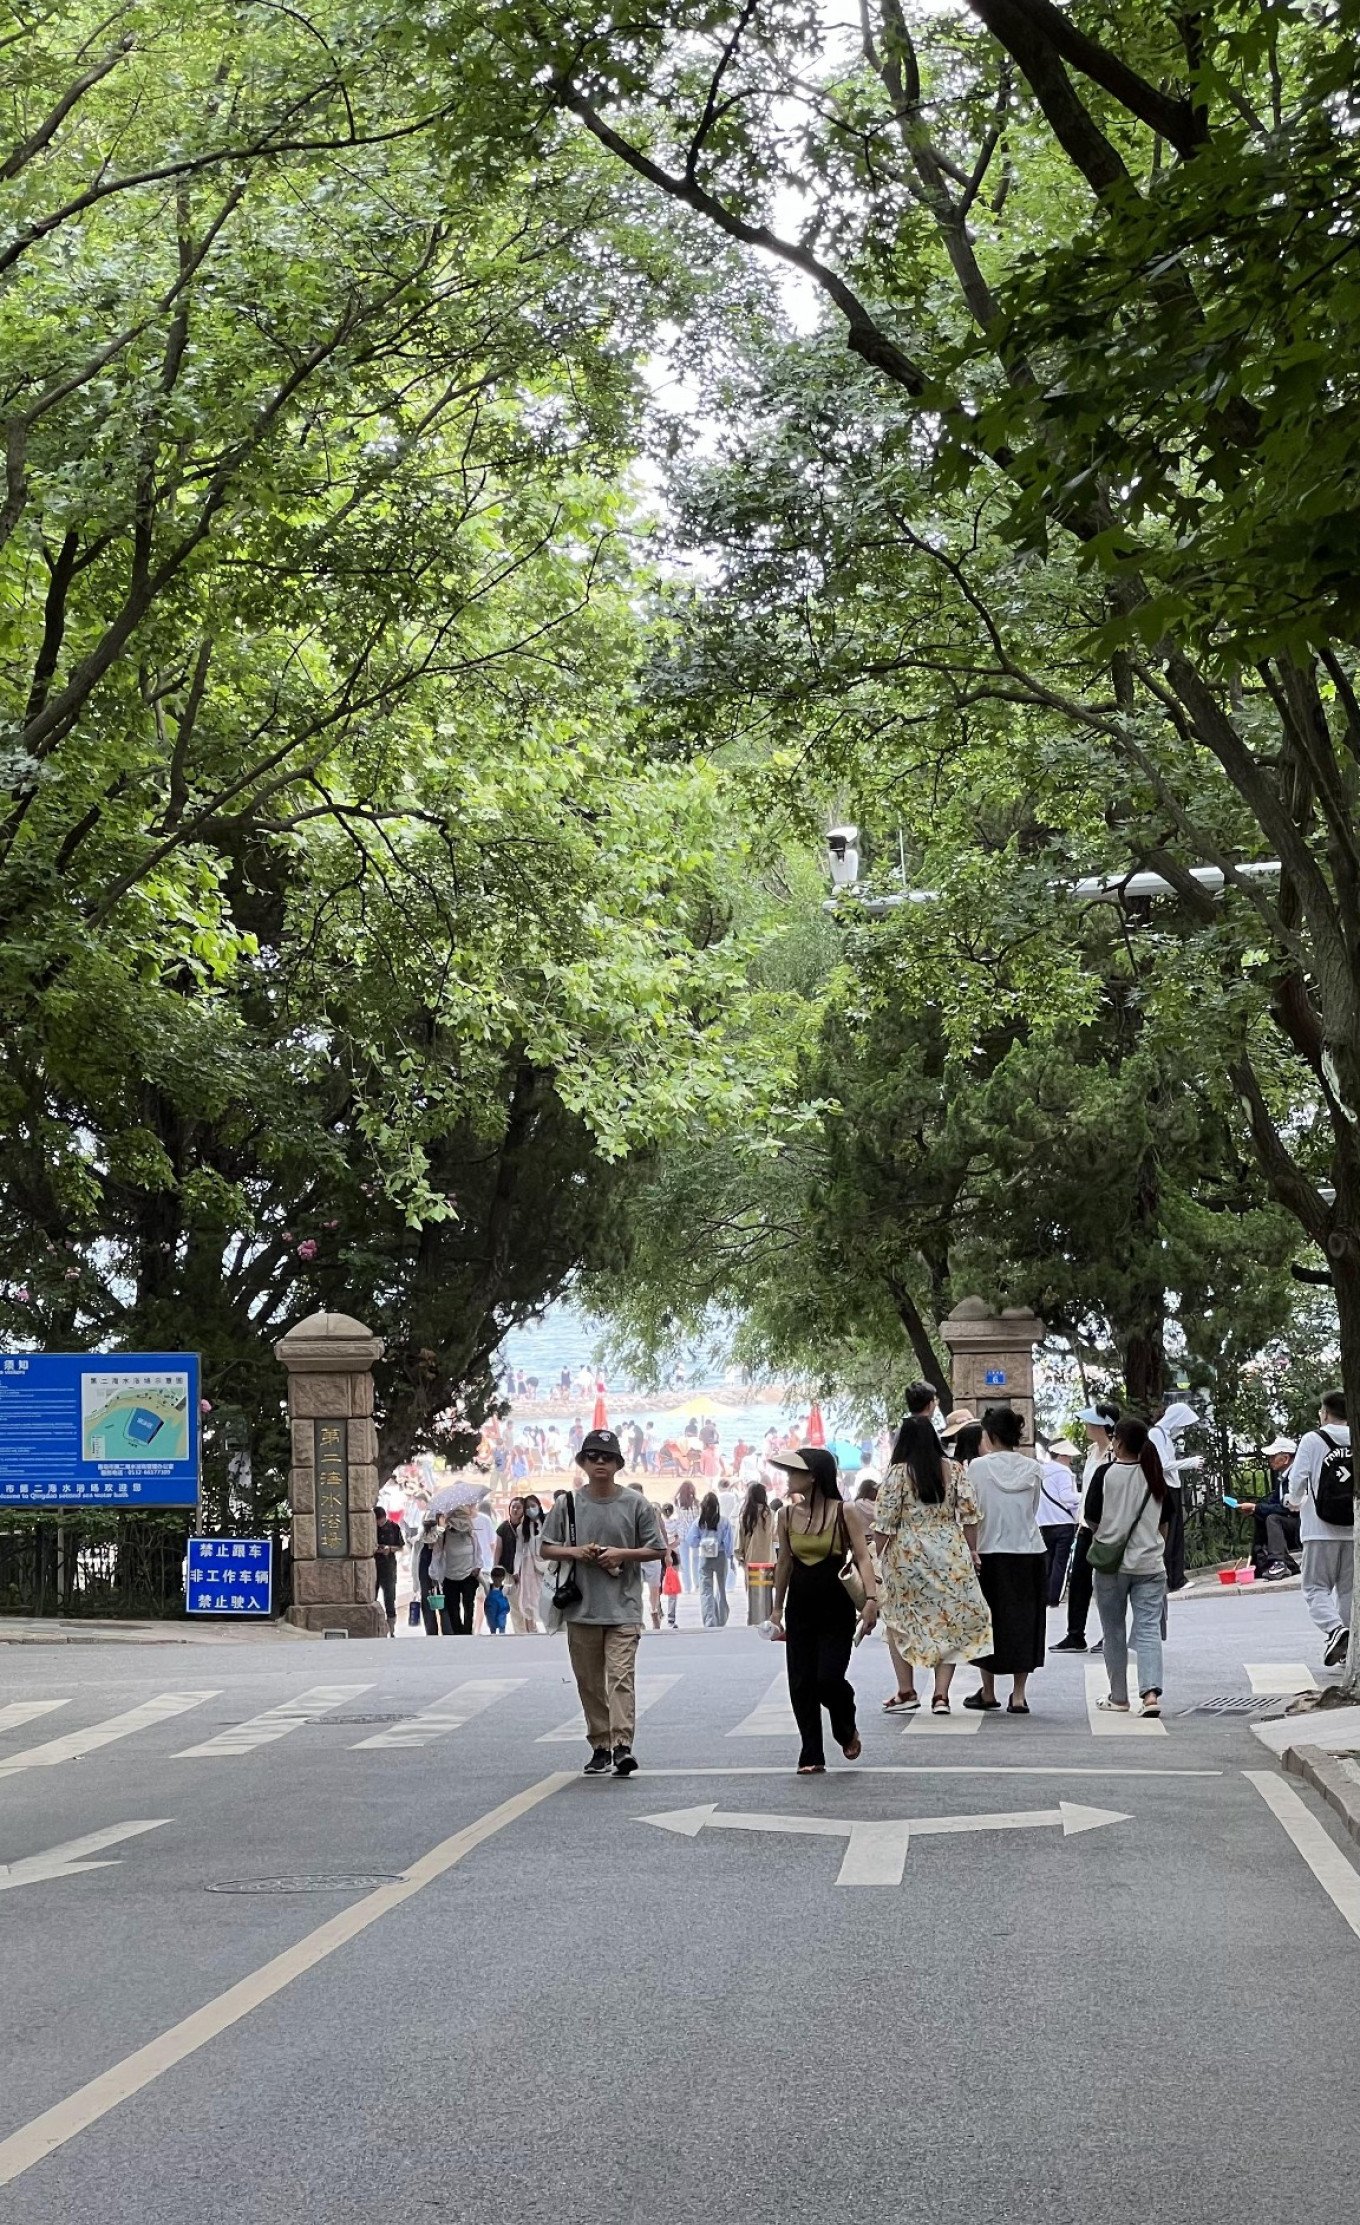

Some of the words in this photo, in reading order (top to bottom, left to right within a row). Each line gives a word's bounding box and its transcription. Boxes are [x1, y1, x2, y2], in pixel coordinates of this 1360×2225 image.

[320, 1427, 342, 1550] 第二海水浴场
[190, 1569, 269, 1584] 非工作车辆
[198, 1595, 261, 1609] 禁止驶入
